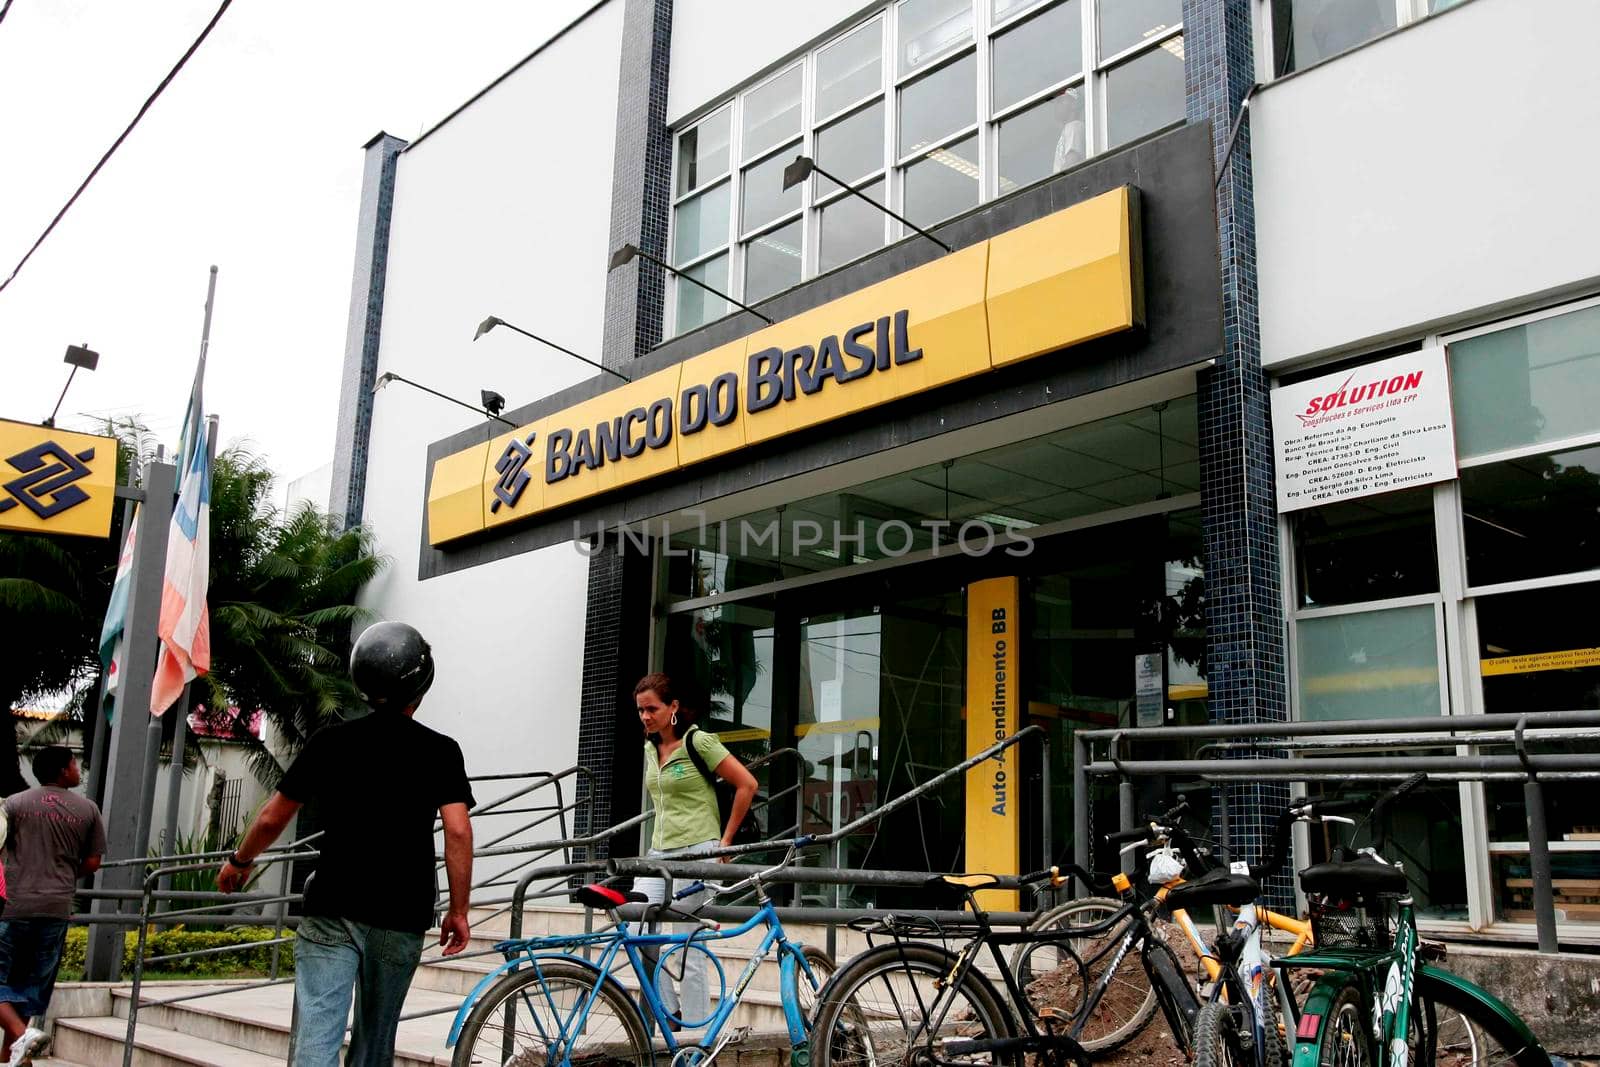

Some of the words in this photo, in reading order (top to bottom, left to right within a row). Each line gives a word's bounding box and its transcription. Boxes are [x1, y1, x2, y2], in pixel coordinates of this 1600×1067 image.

[545, 397, 674, 485] BANCO
[679, 371, 739, 436] DO
[746, 308, 924, 415] BRASIL
[1305, 370, 1423, 415] SOLUTION
[1403, 393, 1418, 404] EPP
[1304, 431, 1334, 441] Reforma
[1402, 428, 1421, 437] Silva
[1423, 423, 1447, 433] Lessa
[1284, 445, 1306, 454] Banco
[1318, 437, 1339, 446] Brasil
[1307, 457, 1330, 466] CREA:
[1382, 441, 1400, 450] Civil
[1373, 451, 1400, 461] Santos
[1308, 475, 1330, 485] CREA:
[1385, 455, 1426, 468] Eletricista
[1354, 475, 1373, 484] Silva
[1375, 471, 1394, 480] Lima
[1392, 471, 1433, 484] Eletricista
[991, 607, 1007, 634] BB
[991, 639, 1007, 817] Auto-Aendimento
